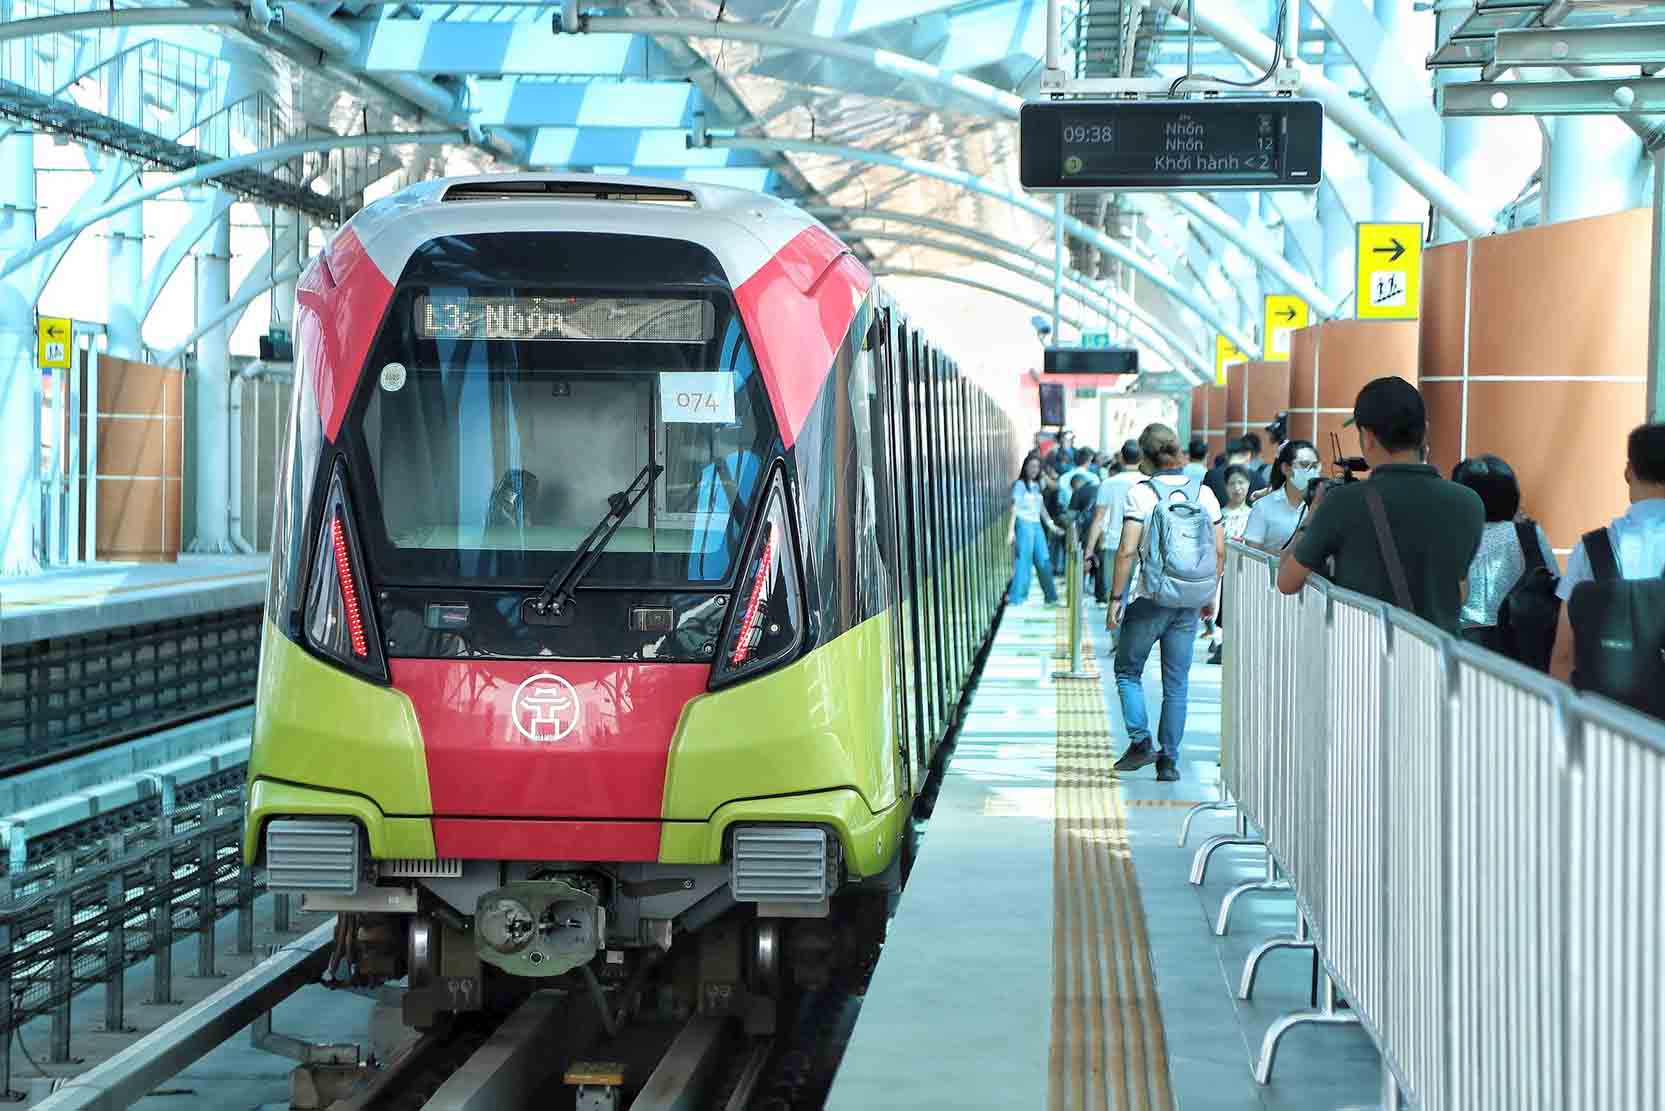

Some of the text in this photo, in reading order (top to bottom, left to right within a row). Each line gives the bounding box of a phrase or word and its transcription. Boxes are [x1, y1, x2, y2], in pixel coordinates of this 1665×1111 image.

[1064, 126, 1112, 143] 09:38
[1197, 153, 1239, 170] hành
[675, 392, 719, 413] 074
